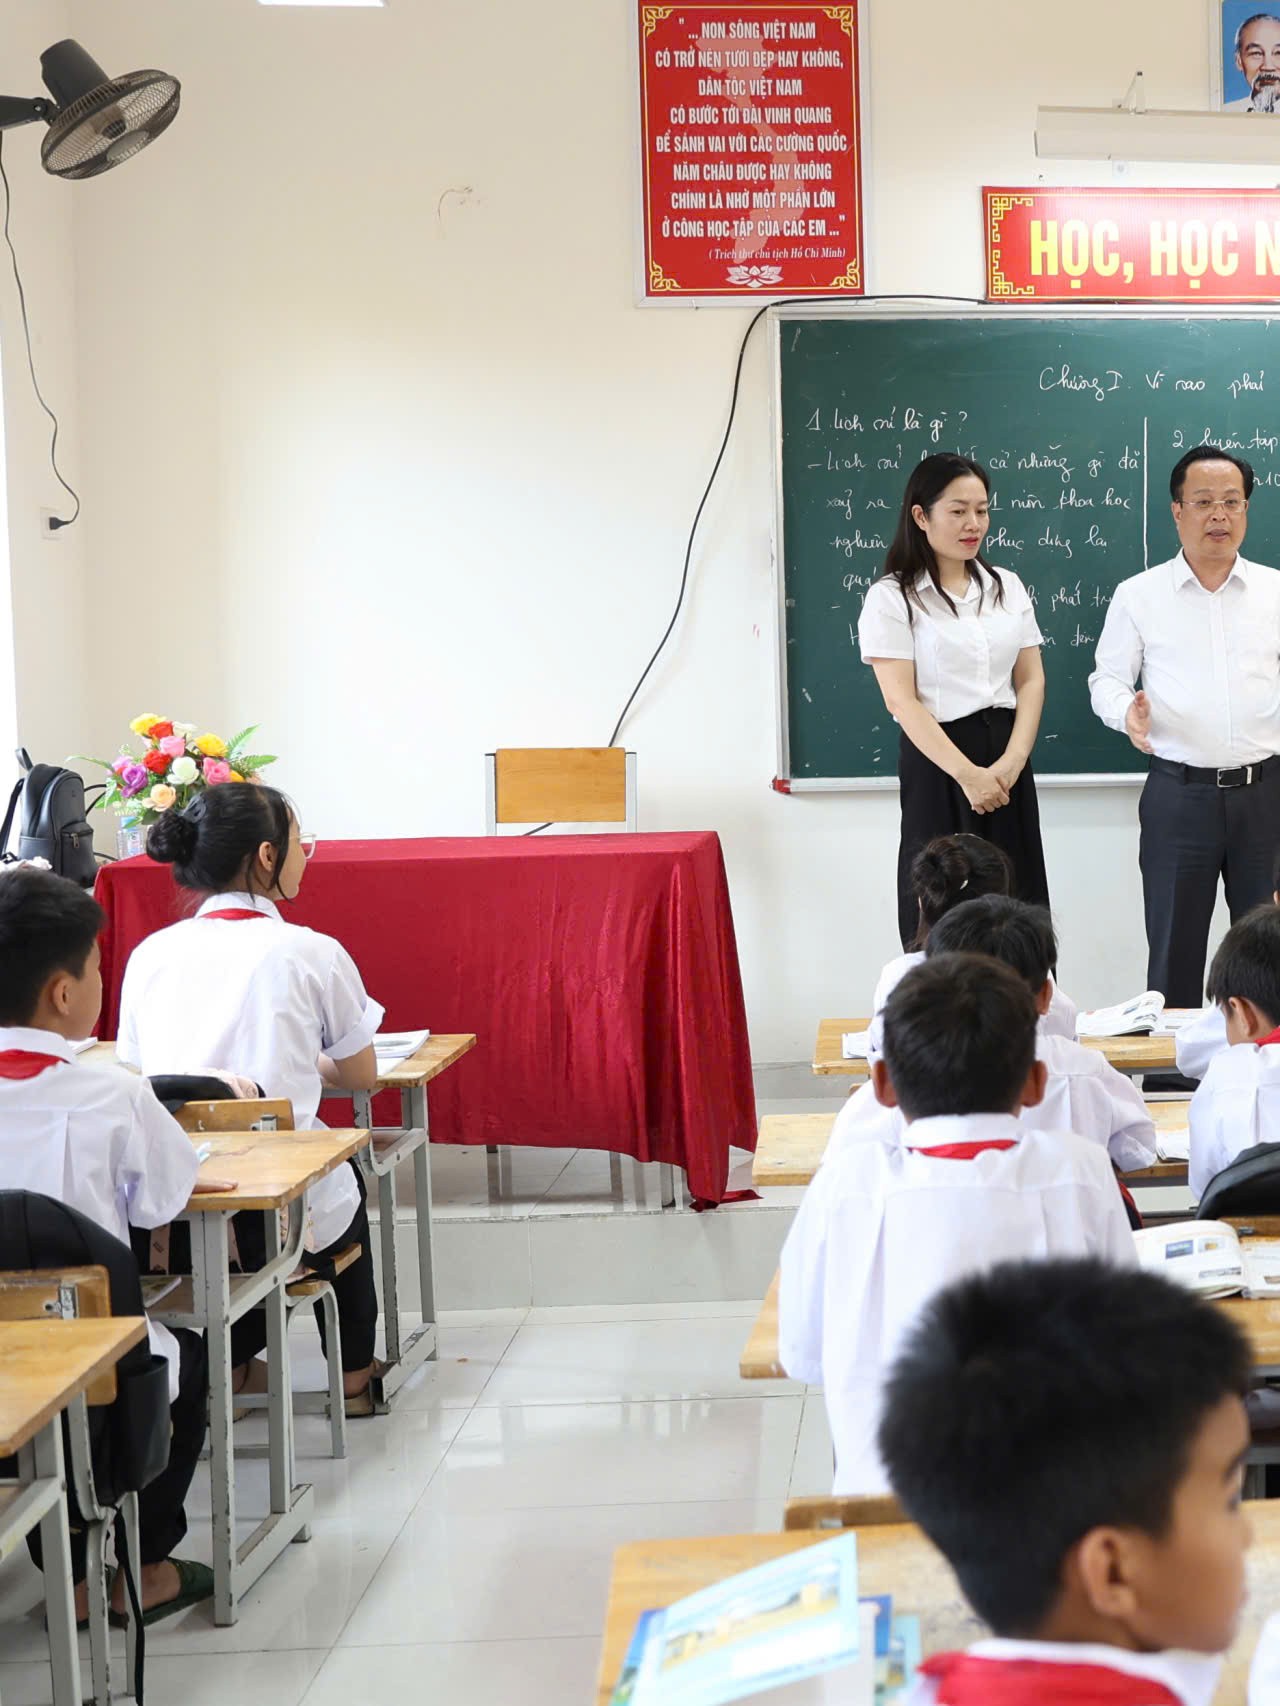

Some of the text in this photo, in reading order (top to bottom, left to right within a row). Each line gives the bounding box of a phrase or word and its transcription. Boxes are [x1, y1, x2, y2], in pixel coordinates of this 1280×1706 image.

[702, 22, 726, 39] NON
[729, 19, 760, 39] SÔNG
[763, 19, 786, 43] VIỆT
[790, 22, 816, 39] NAM
[655, 45, 844, 71] CÓ TRỞ NÊN TƯƠI ĐẸP HAY KHÔNG,
[698, 76, 802, 100] DÂN TỘC VIỆT NAM
[670, 104, 832, 125] CÓ BƯỚC TỚI ĐÀI VINH QUANG
[656, 129, 847, 153] ĐỂ SÁNH VAI VỚI CÁC CƯỜNG QUỐC
[673, 160, 832, 184] NĂM CHÂU ĐƯỢC HAY KHÔNG
[671, 189, 706, 209] CHÍNH
[709, 189, 723, 209] LÀ
[726, 188, 750, 209] NHỜ
[753, 189, 776, 212] MỘT
[814, 188, 835, 208] LỚN
[662, 216, 670, 238] Ở
[673, 217, 704, 237] CÔNG
[707, 220, 730, 241] HỌC
[733, 216, 754, 241] TẬP
[757, 214, 780, 237] CỦA
[783, 217, 806, 237] CÁC
[808, 220, 826, 236] EM
[1030, 219, 1134, 289] HỌC,
[1150, 219, 1240, 288] HỌC
[903, 407, 924, 432] là
[866, 498, 892, 510] ra
